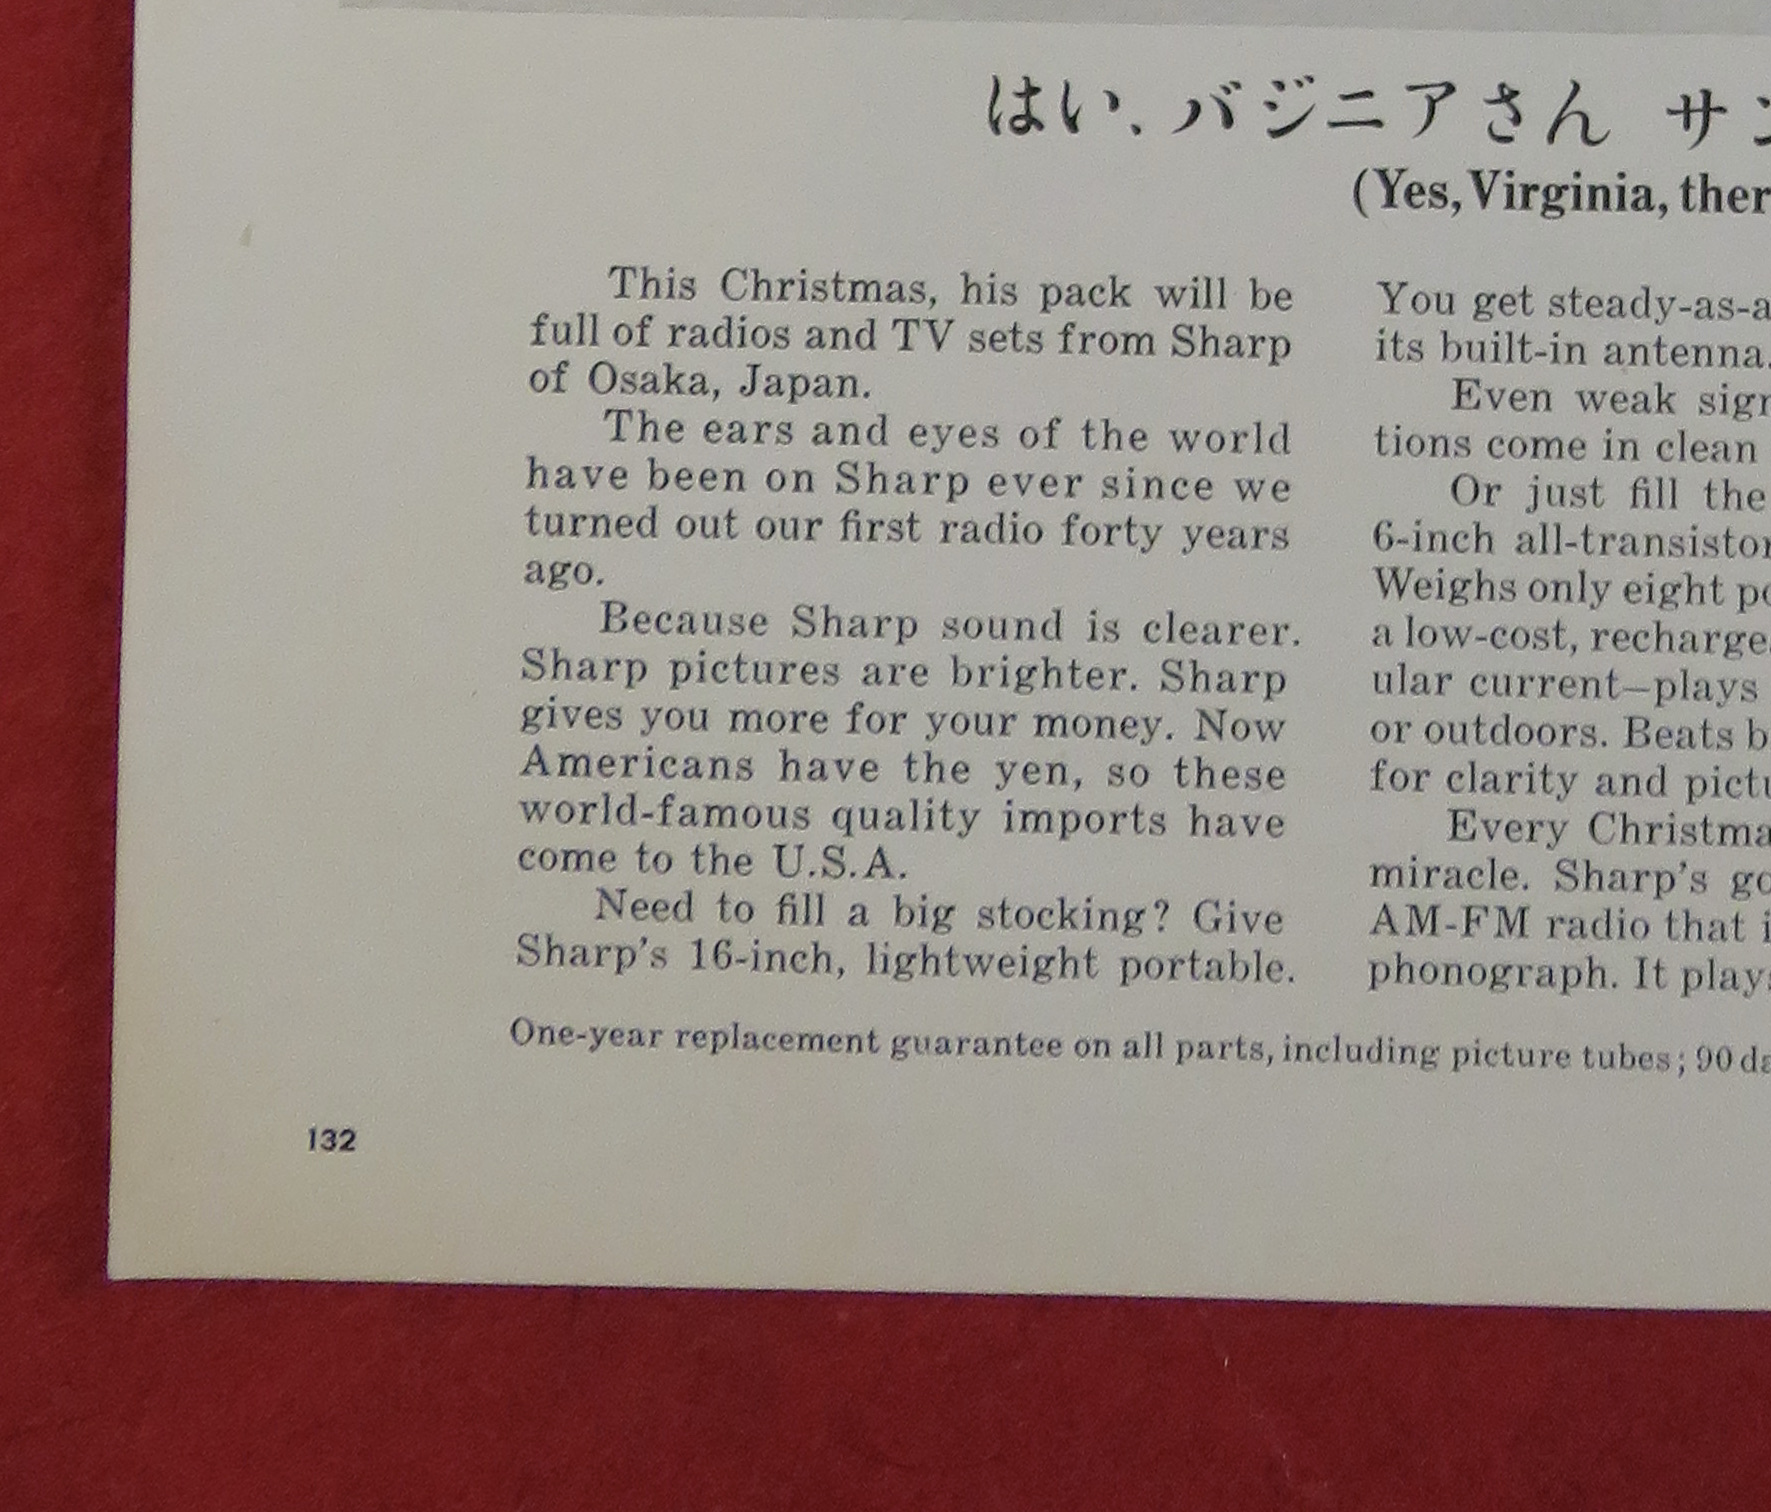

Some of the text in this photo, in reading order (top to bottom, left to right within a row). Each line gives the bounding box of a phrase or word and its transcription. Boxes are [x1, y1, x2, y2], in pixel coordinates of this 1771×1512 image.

[608, 265, 1292, 314] This Christmas, his pack will be
[1377, 281, 1455, 315] You
[1473, 285, 1534, 322] get
[530, 312, 1291, 366] full of radios and TV sets from Sharp
[1376, 328, 1424, 362] its
[1441, 330, 1586, 365] built-in
[529, 360, 870, 404] of Osaka, Japan.
[1451, 378, 1552, 412] Even
[1575, 381, 1676, 414] weak
[1373, 519, 1493, 554] 6-inch
[1373, 566, 1516, 606] Weighs
[1529, 569, 1611, 610] only
[1623, 572, 1724, 610] eight
[600, 600, 1299, 646] Because Sharp sound is clearer.
[1372, 625, 1393, 647] a
[1406, 614, 1577, 656] low-cost,
[520, 696, 1285, 746] gives you more for your money. Now
[520, 744, 1285, 791] Americans have the yen, so these
[519, 792, 1284, 841] world-famous quality imports have
[1370, 855, 1528, 891] miracle.
[1555, 858, 1707, 900] Sharp's
[517, 933, 1294, 987] Sharp's 16-inch, lightweight portable.
[510, 1017, 663, 1053] One-year
[676, 1022, 880, 1055] replacement
[891, 1032, 1062, 1061] guarantee
[1074, 1039, 1110, 1058] on
[1123, 1031, 1162, 1059] all
[1176, 1035, 1273, 1067] parts,
[1283, 1034, 1440, 1071] including
[1452, 1038, 1570, 1072] picture
[1583, 1042, 1684, 1077] tubes;
[1696, 1045, 1732, 1073] 90
[309, 1127, 356, 1152] 132
